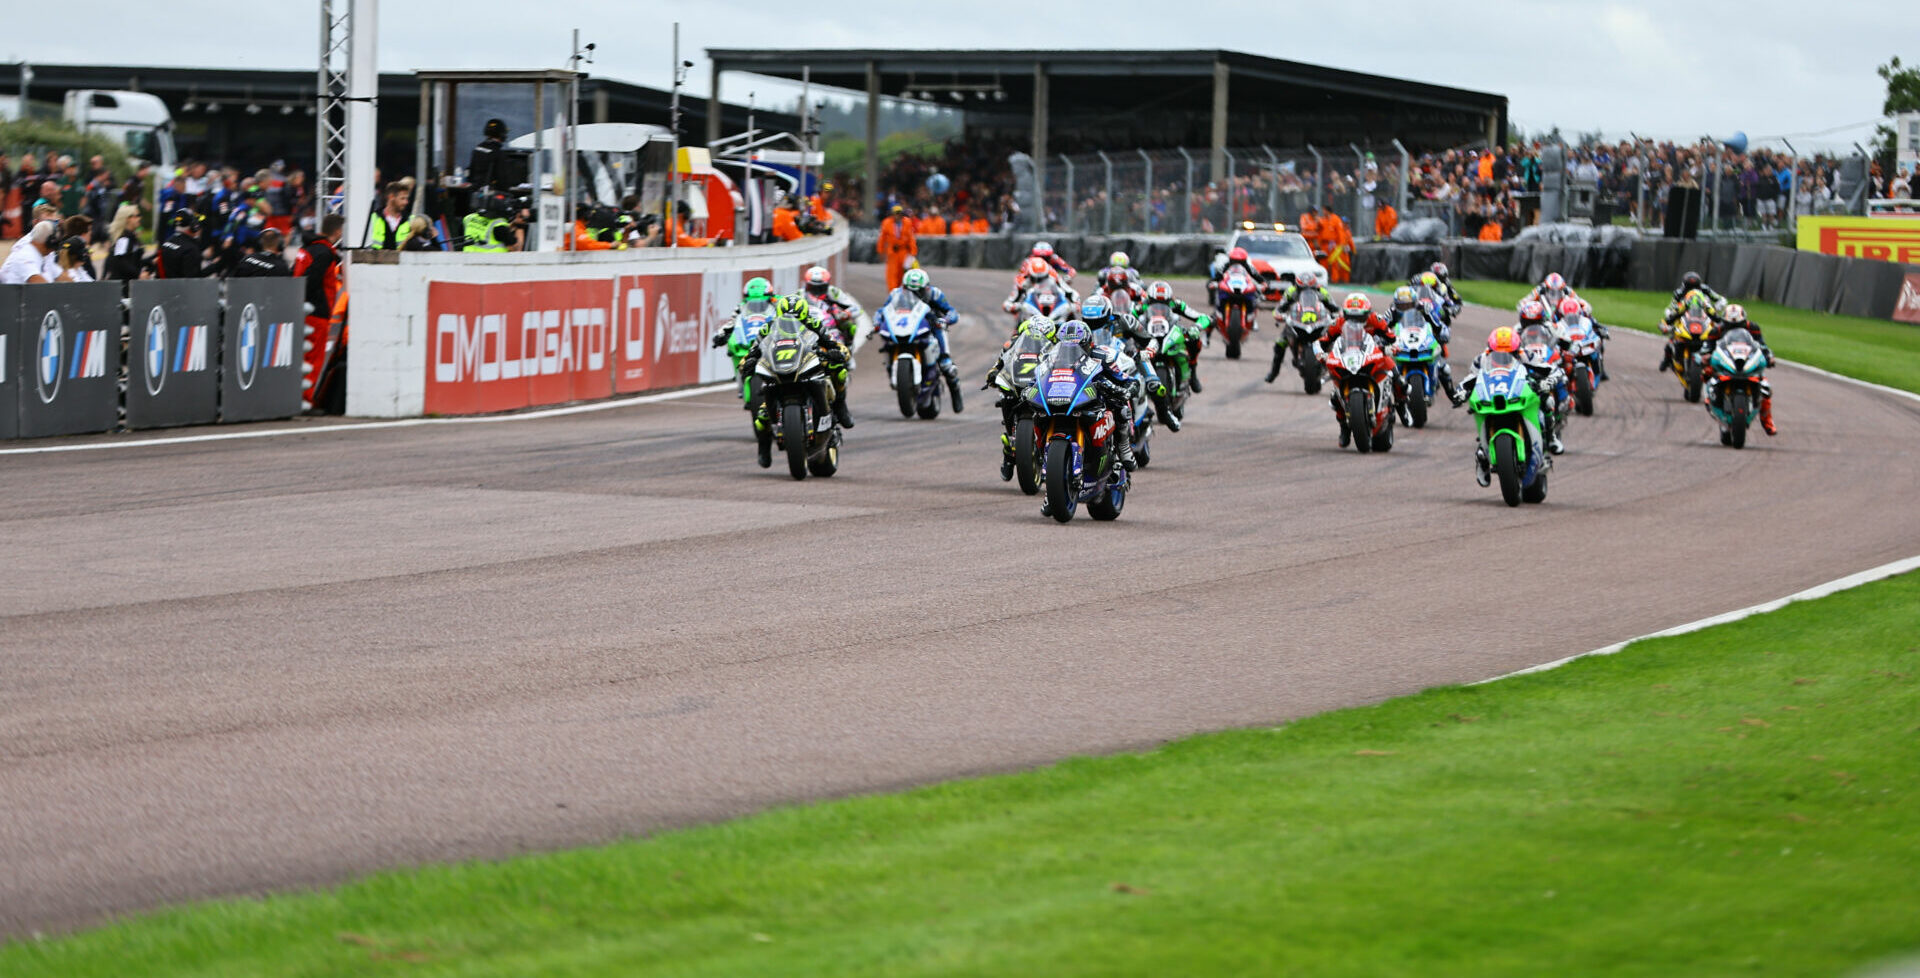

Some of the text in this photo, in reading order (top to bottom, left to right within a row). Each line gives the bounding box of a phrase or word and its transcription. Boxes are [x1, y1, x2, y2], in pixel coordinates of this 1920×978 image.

[896, 317, 908, 329] 4
[1408, 333, 1419, 343] 5
[437, 308, 605, 382] OMOLOGATO
[775, 348, 798, 361] 77
[1018, 362, 1038, 375] 7
[1488, 382, 1509, 395] 14
